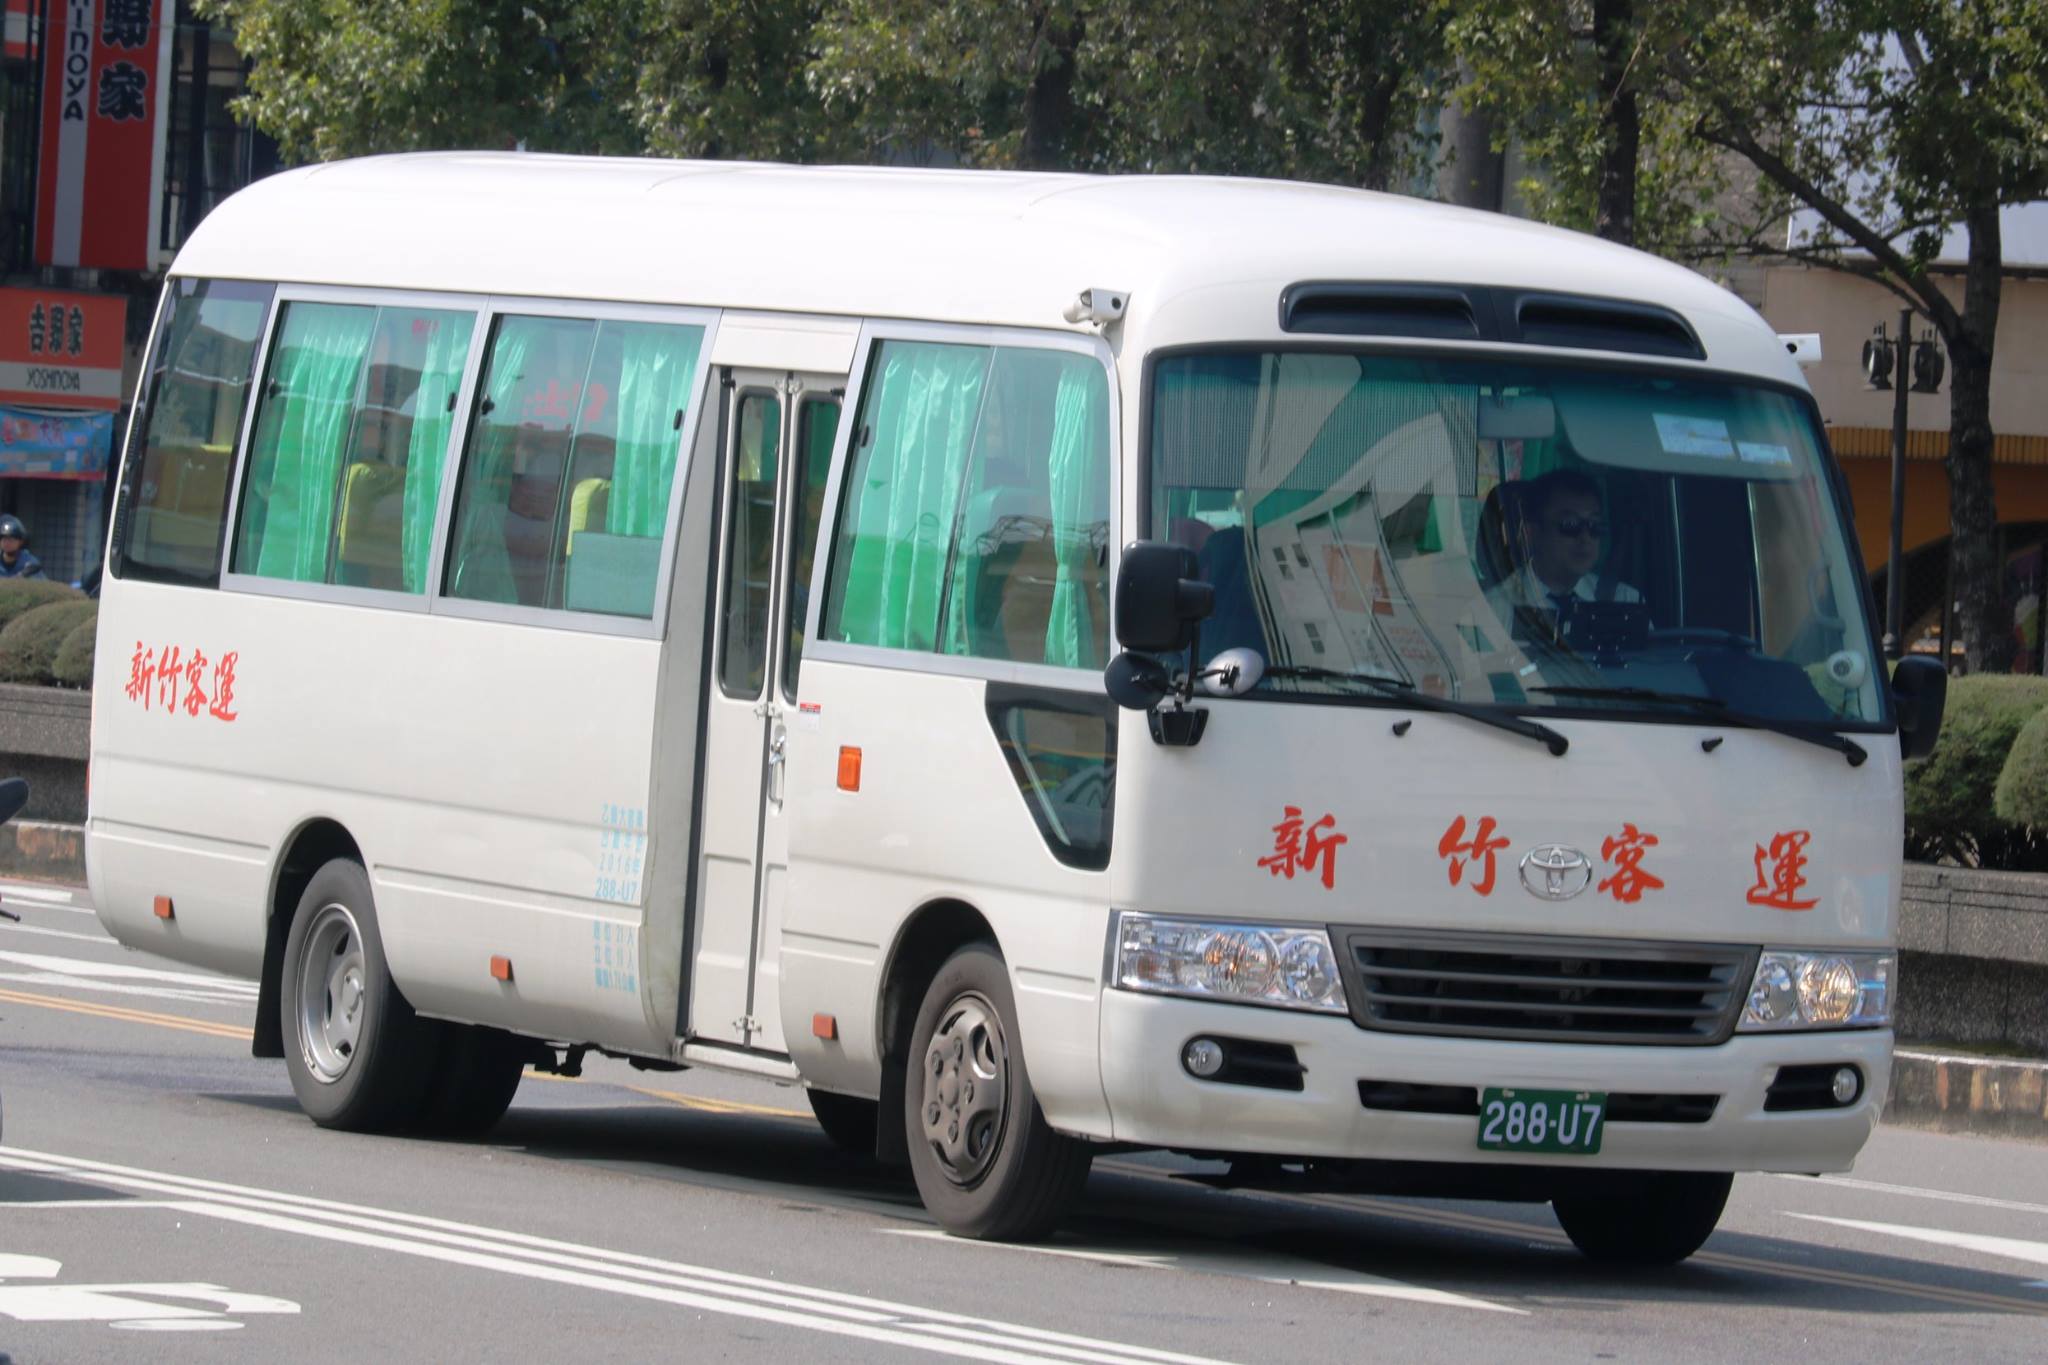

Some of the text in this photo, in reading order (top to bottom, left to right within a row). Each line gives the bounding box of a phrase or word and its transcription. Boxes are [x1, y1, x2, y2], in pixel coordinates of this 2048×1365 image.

[125, 640, 239, 721] 新竹客運
[1257, 805, 1821, 911] 新竹客運
[1483, 1100, 1601, 1147] 288-U7
